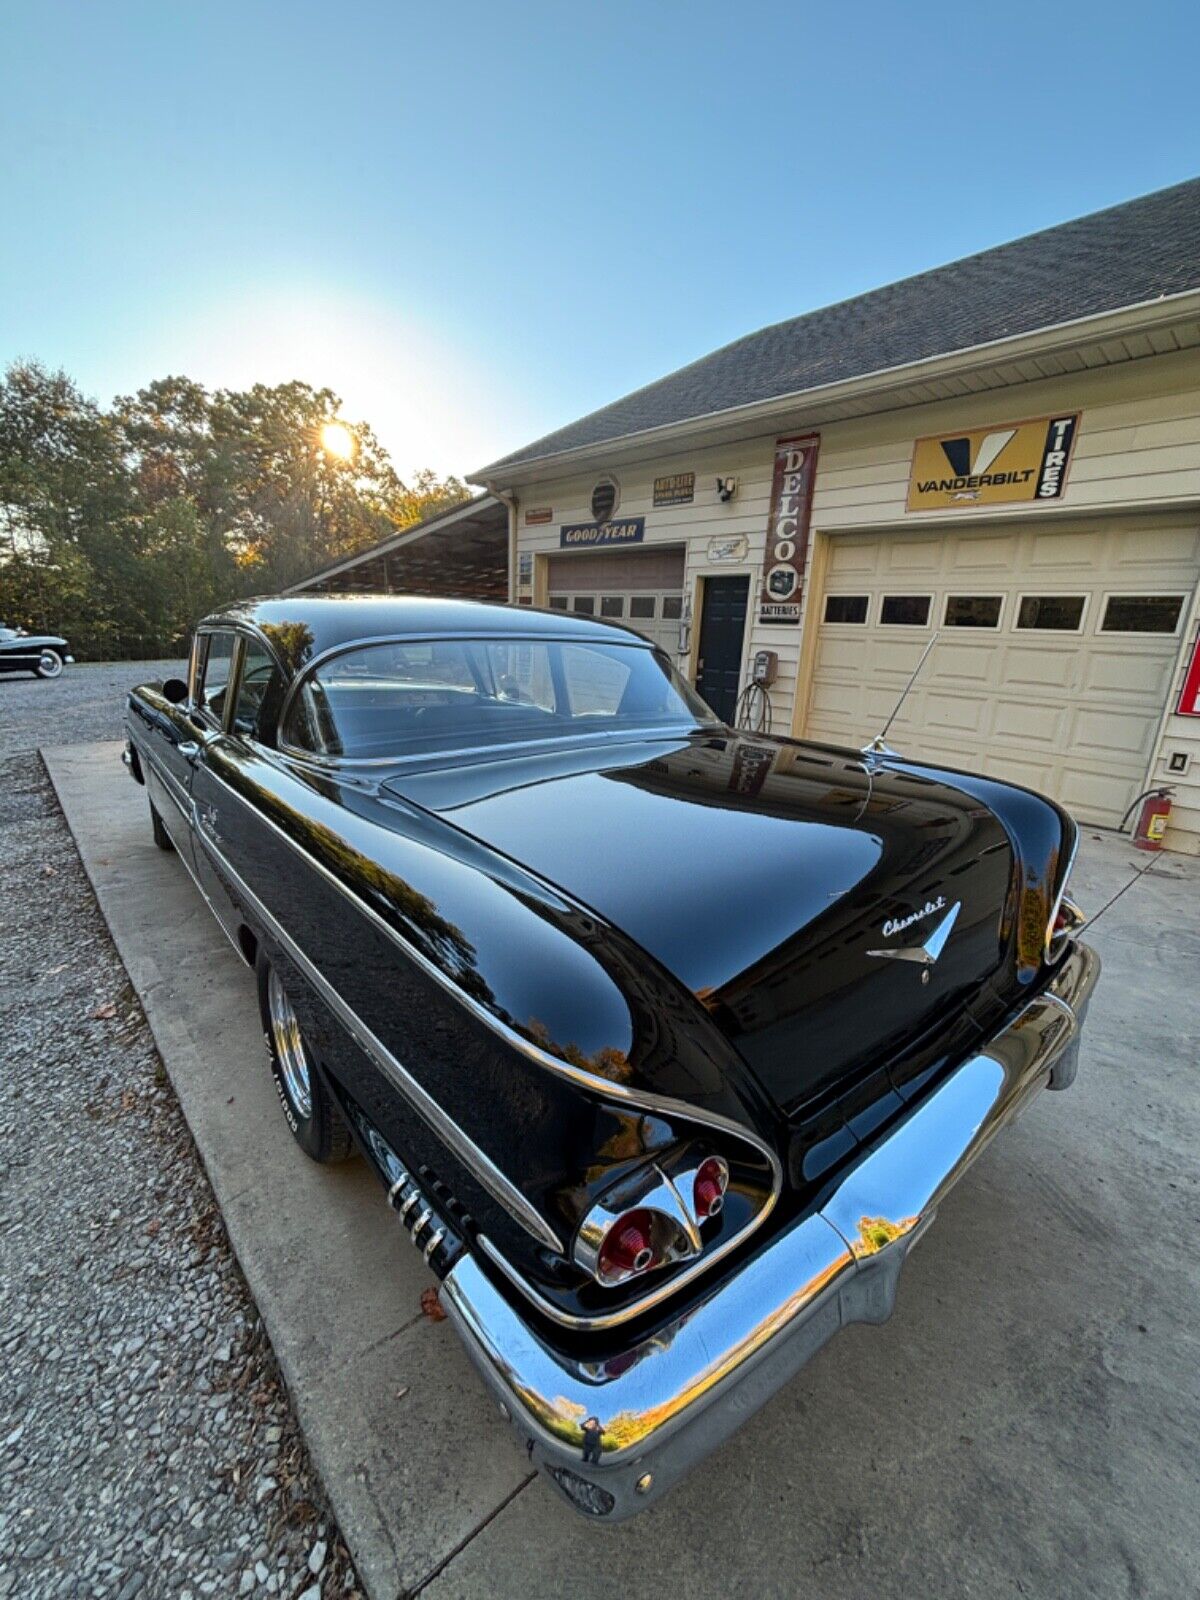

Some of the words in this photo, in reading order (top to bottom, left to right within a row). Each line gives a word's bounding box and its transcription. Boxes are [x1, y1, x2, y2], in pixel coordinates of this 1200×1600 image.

[1039, 419, 1072, 497] TIRES
[917, 469, 1035, 493] VANDERBILT
[774, 450, 804, 562] DELCO
[761, 605, 798, 616] BATTERIES
[882, 896, 946, 938] Chevrolet
